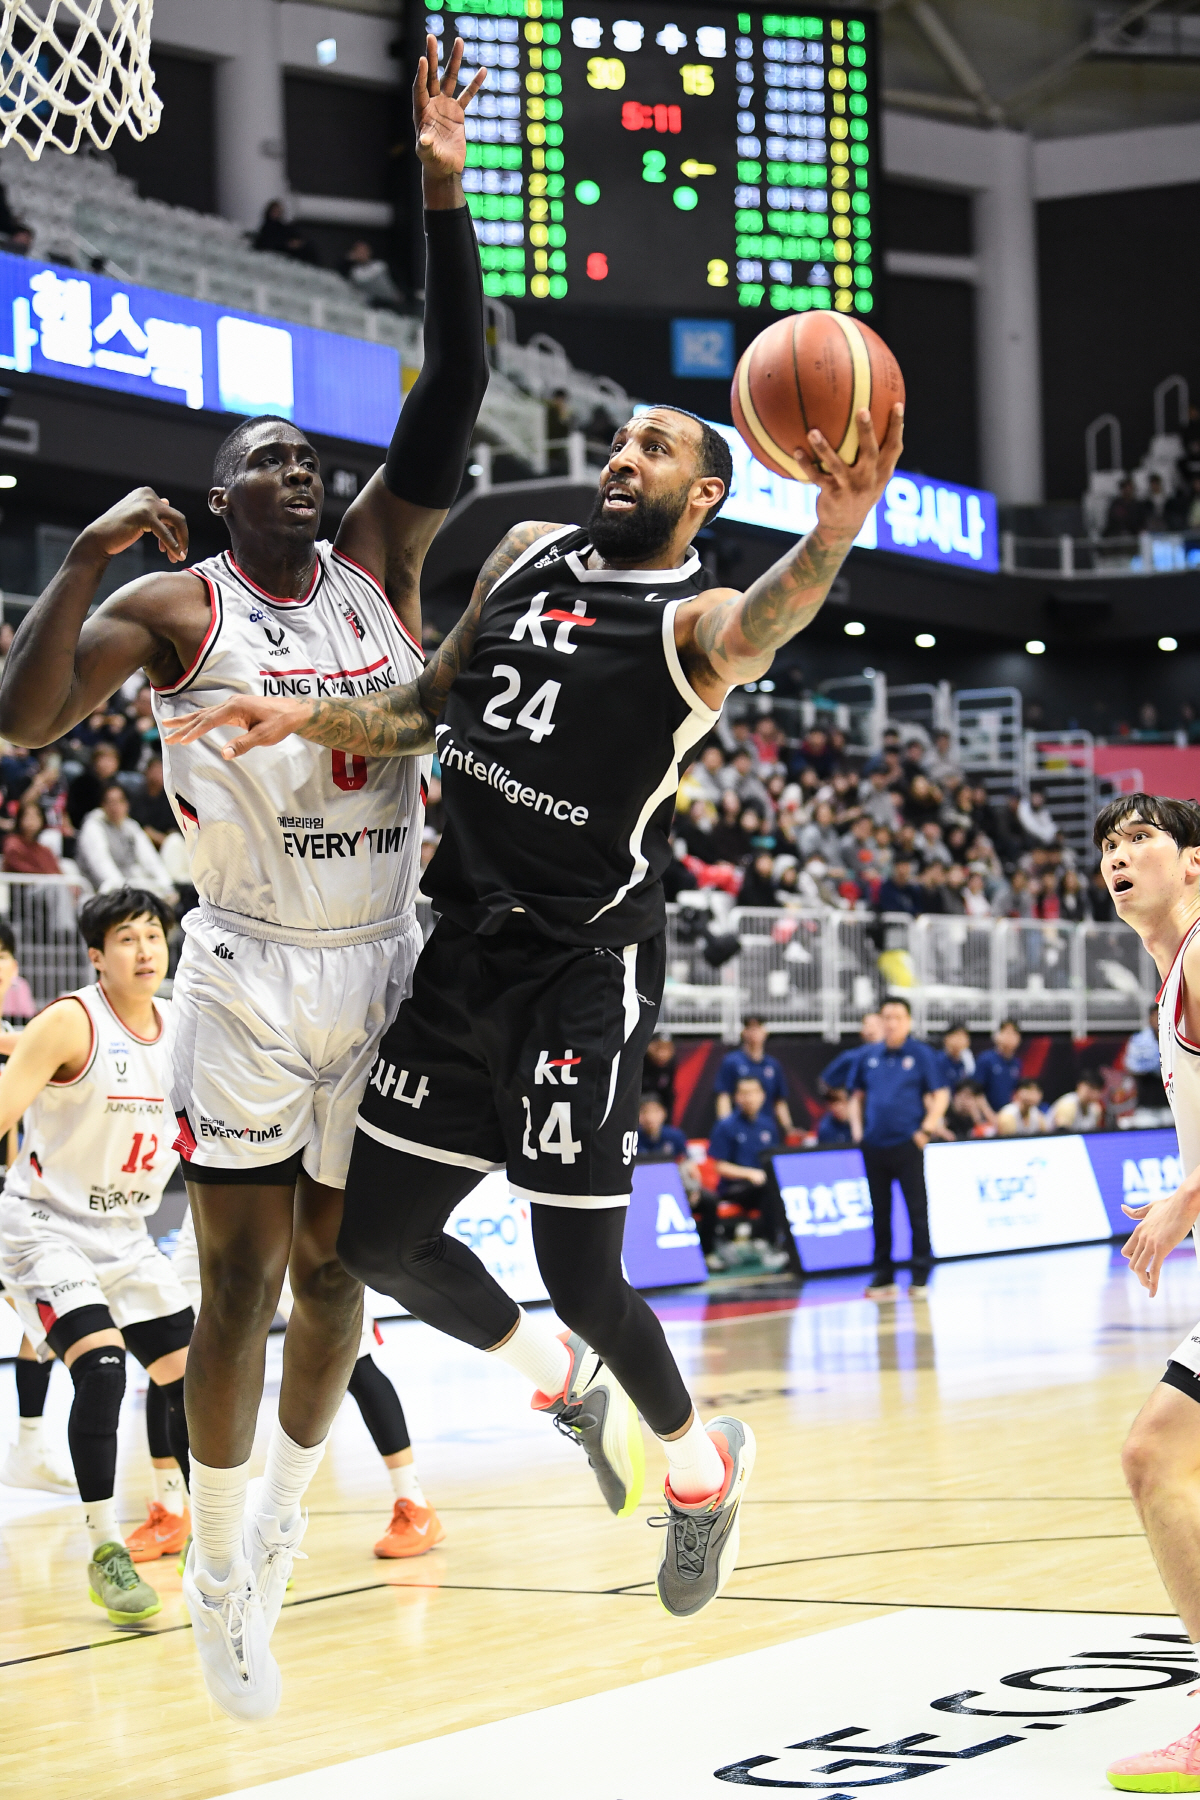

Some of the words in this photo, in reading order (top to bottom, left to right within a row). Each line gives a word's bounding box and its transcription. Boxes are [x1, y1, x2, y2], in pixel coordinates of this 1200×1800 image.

[679, 64, 714, 96] 15
[642, 150, 666, 183] 2
[707, 259, 729, 287] 2
[510, 591, 597, 655] kt
[268, 646, 291, 657] VEXX
[482, 664, 562, 744] 24
[439, 739, 589, 826] intelligence
[369, 1057, 430, 1110] 사나
[534, 1049, 582, 1085] kt
